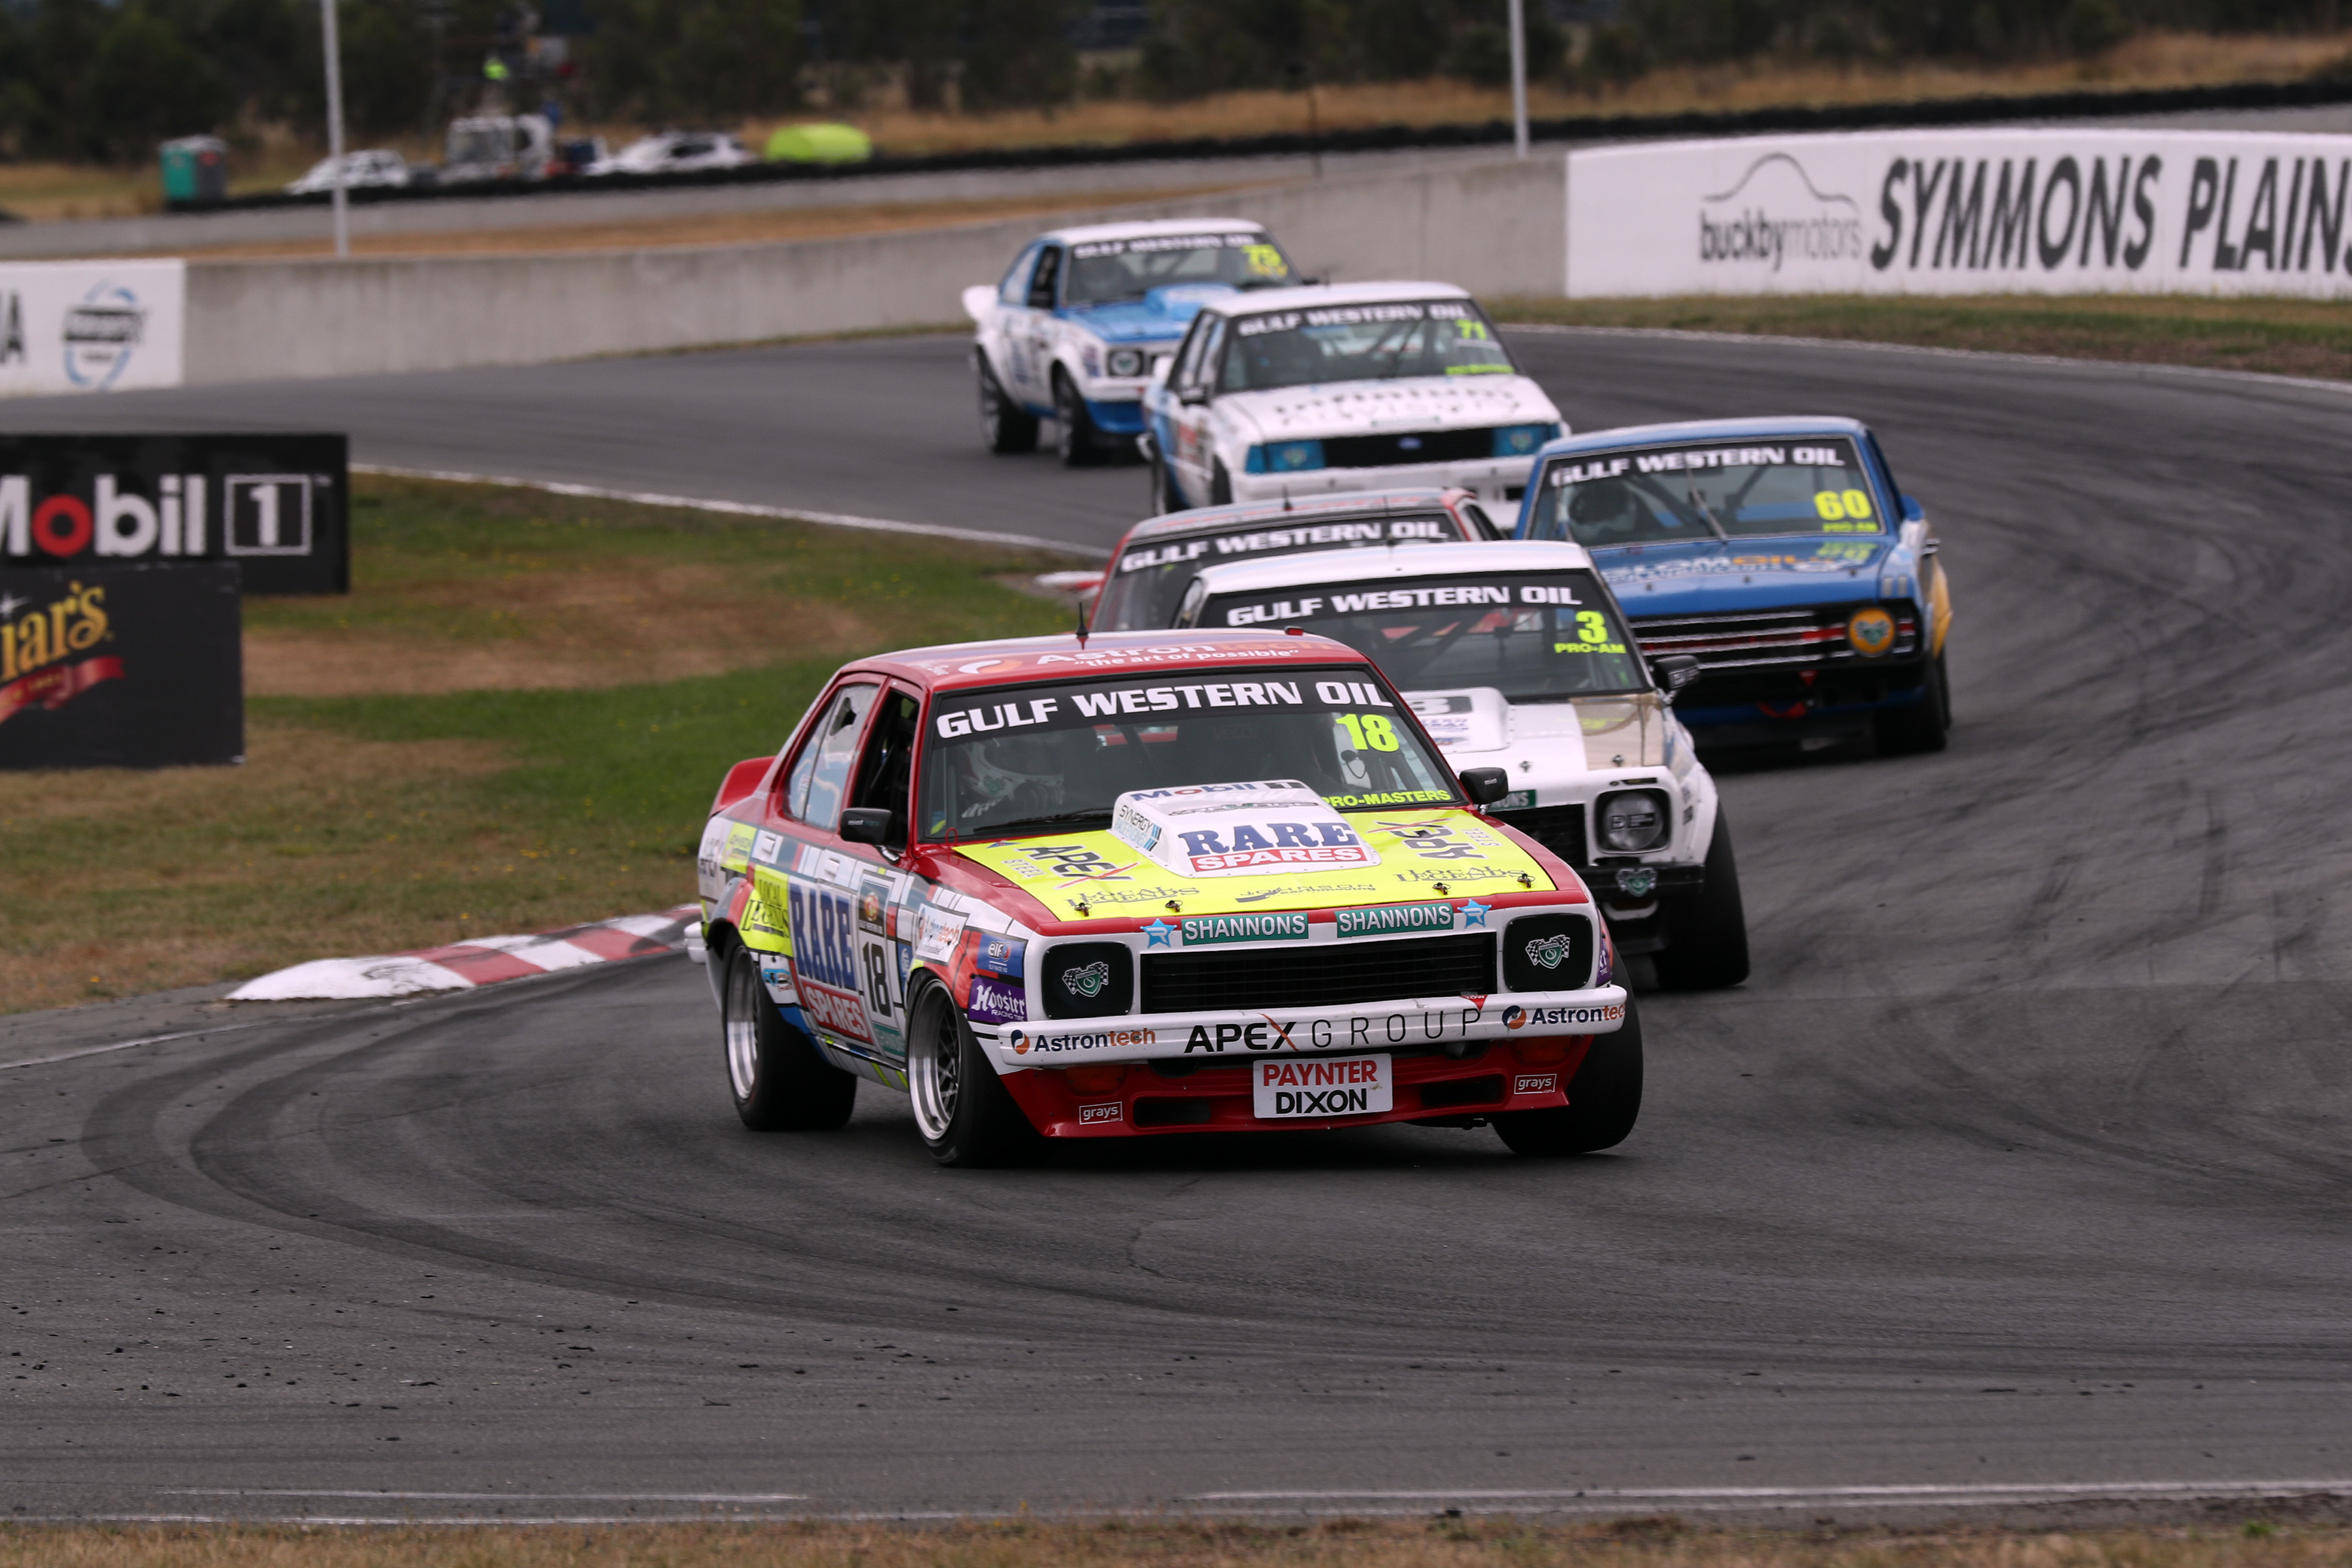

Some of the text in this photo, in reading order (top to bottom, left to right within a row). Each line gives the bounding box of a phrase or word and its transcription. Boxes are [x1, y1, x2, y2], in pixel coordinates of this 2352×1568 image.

[1869, 155, 2163, 271] SYMMONS
[1305, 305, 1425, 327] WESTERN
[1428, 303, 1470, 321] OIL
[1551, 447, 1845, 487] GULF WESTERN OIL
[1814, 489, 1874, 521] 60
[1121, 521, 1450, 572] GULF WESTERN OIL
[1227, 585, 1583, 627] GULF WESTERN OIL
[1576, 610, 1609, 644] 3
[1132, 655, 1162, 663] art
[1171, 652, 1191, 661] of
[1554, 642, 1627, 655] PRO-AM
[936, 681, 1395, 739] GULF WESTERN OIL
[1335, 713, 1400, 753] 18
[1130, 783, 1257, 802] Mobil
[1321, 789, 1452, 808] PRO-MASTERS
[1119, 804, 1154, 834] SYNERGY
[1178, 822, 1362, 857] RARE
[1366, 818, 1489, 859] APEX
[1462, 827, 1501, 847] STEEL
[1002, 859, 1047, 879] STEEL
[1017, 845, 1140, 889] APEX
[1196, 848, 1363, 872] SPARES
[1240, 884, 1373, 896] JOHNSON
[1184, 915, 1307, 943] SHANNONS
[1339, 905, 1452, 933] SHANNONS
[790, 883, 857, 992] RARE
[988, 941, 1004, 958] elf
[862, 941, 892, 1018] 18
[806, 985, 870, 1038] SPARES
[971, 985, 1026, 1016] Hoosier
[991, 1009, 1013, 1019] RACING
[1531, 1005, 1626, 1025] Astrontec
[1034, 1028, 1156, 1053] Astrontech
[1184, 1008, 1481, 1054] APEX GROUP
[1263, 1060, 1377, 1087] PAYNTER
[1518, 1076, 1552, 1091] grays
[1083, 1105, 1119, 1121] grays
[1276, 1088, 1369, 1115] DIXON
